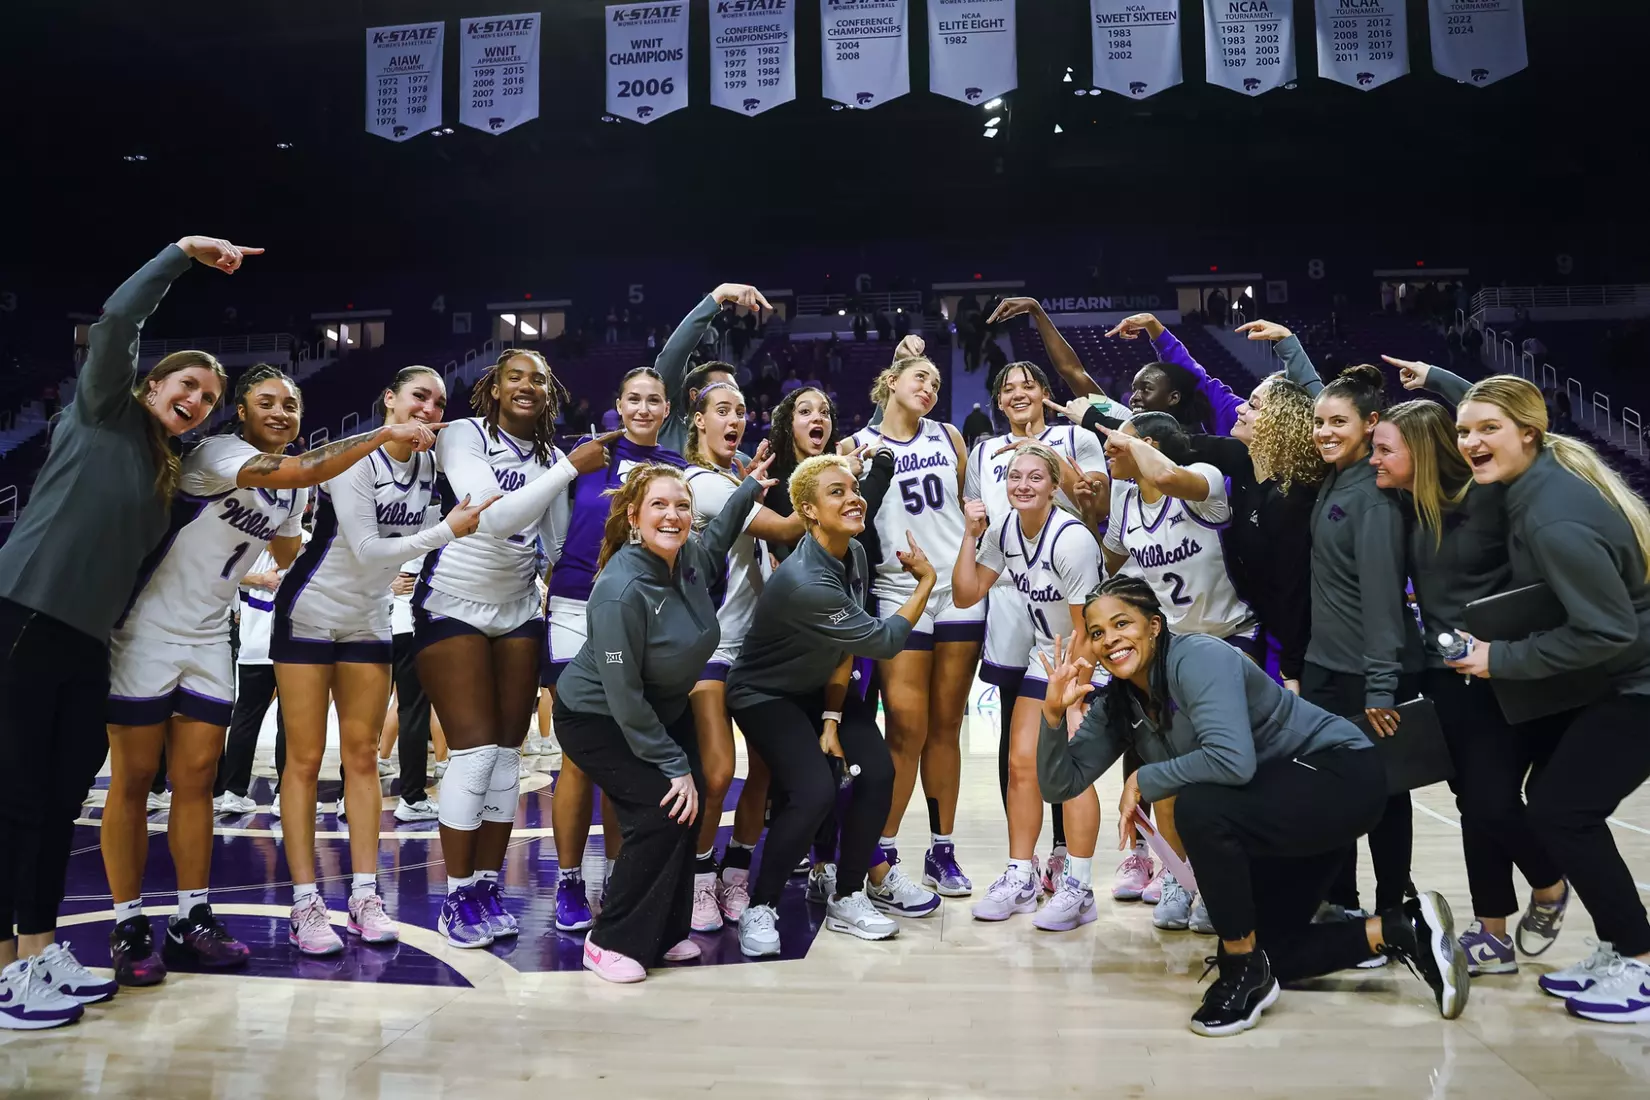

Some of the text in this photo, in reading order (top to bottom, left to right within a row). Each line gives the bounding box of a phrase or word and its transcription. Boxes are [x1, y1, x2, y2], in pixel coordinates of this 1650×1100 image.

[1229, 1, 1268, 13] NCAA
[613, 5, 682, 22] K-STATE
[1096, 11, 1176, 23] SWEET SIXTEEN
[836, 17, 893, 27] CONFERENCE
[939, 19, 1004, 30] ELITE EIGHT
[1333, 19, 1391, 28] 2005 2012
[1448, 16, 1472, 24] 2022
[468, 18, 534, 34] K-STATE
[725, 24, 780, 35] CONFERENCE
[828, 25, 901, 36] CHAMPIONSHIPS
[1222, 24, 1278, 33] 1982 1997
[1448, 26, 1474, 34] 2024
[373, 28, 438, 44] K-STATE
[716, 32, 788, 44] CHAMPIONSHIPS
[1108, 29, 1131, 37] 1983
[1334, 30, 1392, 40] 2008 2016
[630, 38, 663, 49] WNIT
[944, 36, 967, 44] 1982
[1108, 40, 1131, 48] 1984
[1222, 35, 1279, 45] 1983 2002
[836, 42, 860, 50] 2004
[1223, 46, 1279, 56] 1984 2003
[1335, 41, 1392, 51] 2009 2017
[484, 45, 516, 58] WNIT
[609, 48, 683, 65] CHAMPIONS
[724, 49, 746, 57] 1976
[836, 52, 860, 60] 2008
[1108, 51, 1132, 59] 2002
[389, 55, 420, 67] AIAW
[478, 56, 521, 64] APPEARANCES
[1223, 57, 1280, 67] 1987 2004
[1336, 52, 1393, 62] 2011 2019
[724, 57, 779, 68] 1977 1983
[383, 64, 424, 73] TOURNAMENT
[474, 66, 524, 77] 1999 2015
[724, 68, 780, 78] 1978 1984
[408, 75, 428, 83] 1977
[473, 77, 524, 87] 2006 2018
[724, 78, 779, 89] 1979 1987
[378, 88, 398, 96] 1973
[617, 77, 674, 97] 2006
[473, 87, 524, 98] 2007 2023
[472, 100, 493, 108] 2013
[407, 106, 426, 114] 1980
[1308, 259, 1324, 278] 8
[628, 284, 644, 303] 5
[898, 473, 945, 516] 50
[376, 501, 427, 526] Wildcat
[1130, 536, 1203, 568] Wildcats
[220, 541, 251, 580] 1
[1162, 572, 1193, 606] 2
